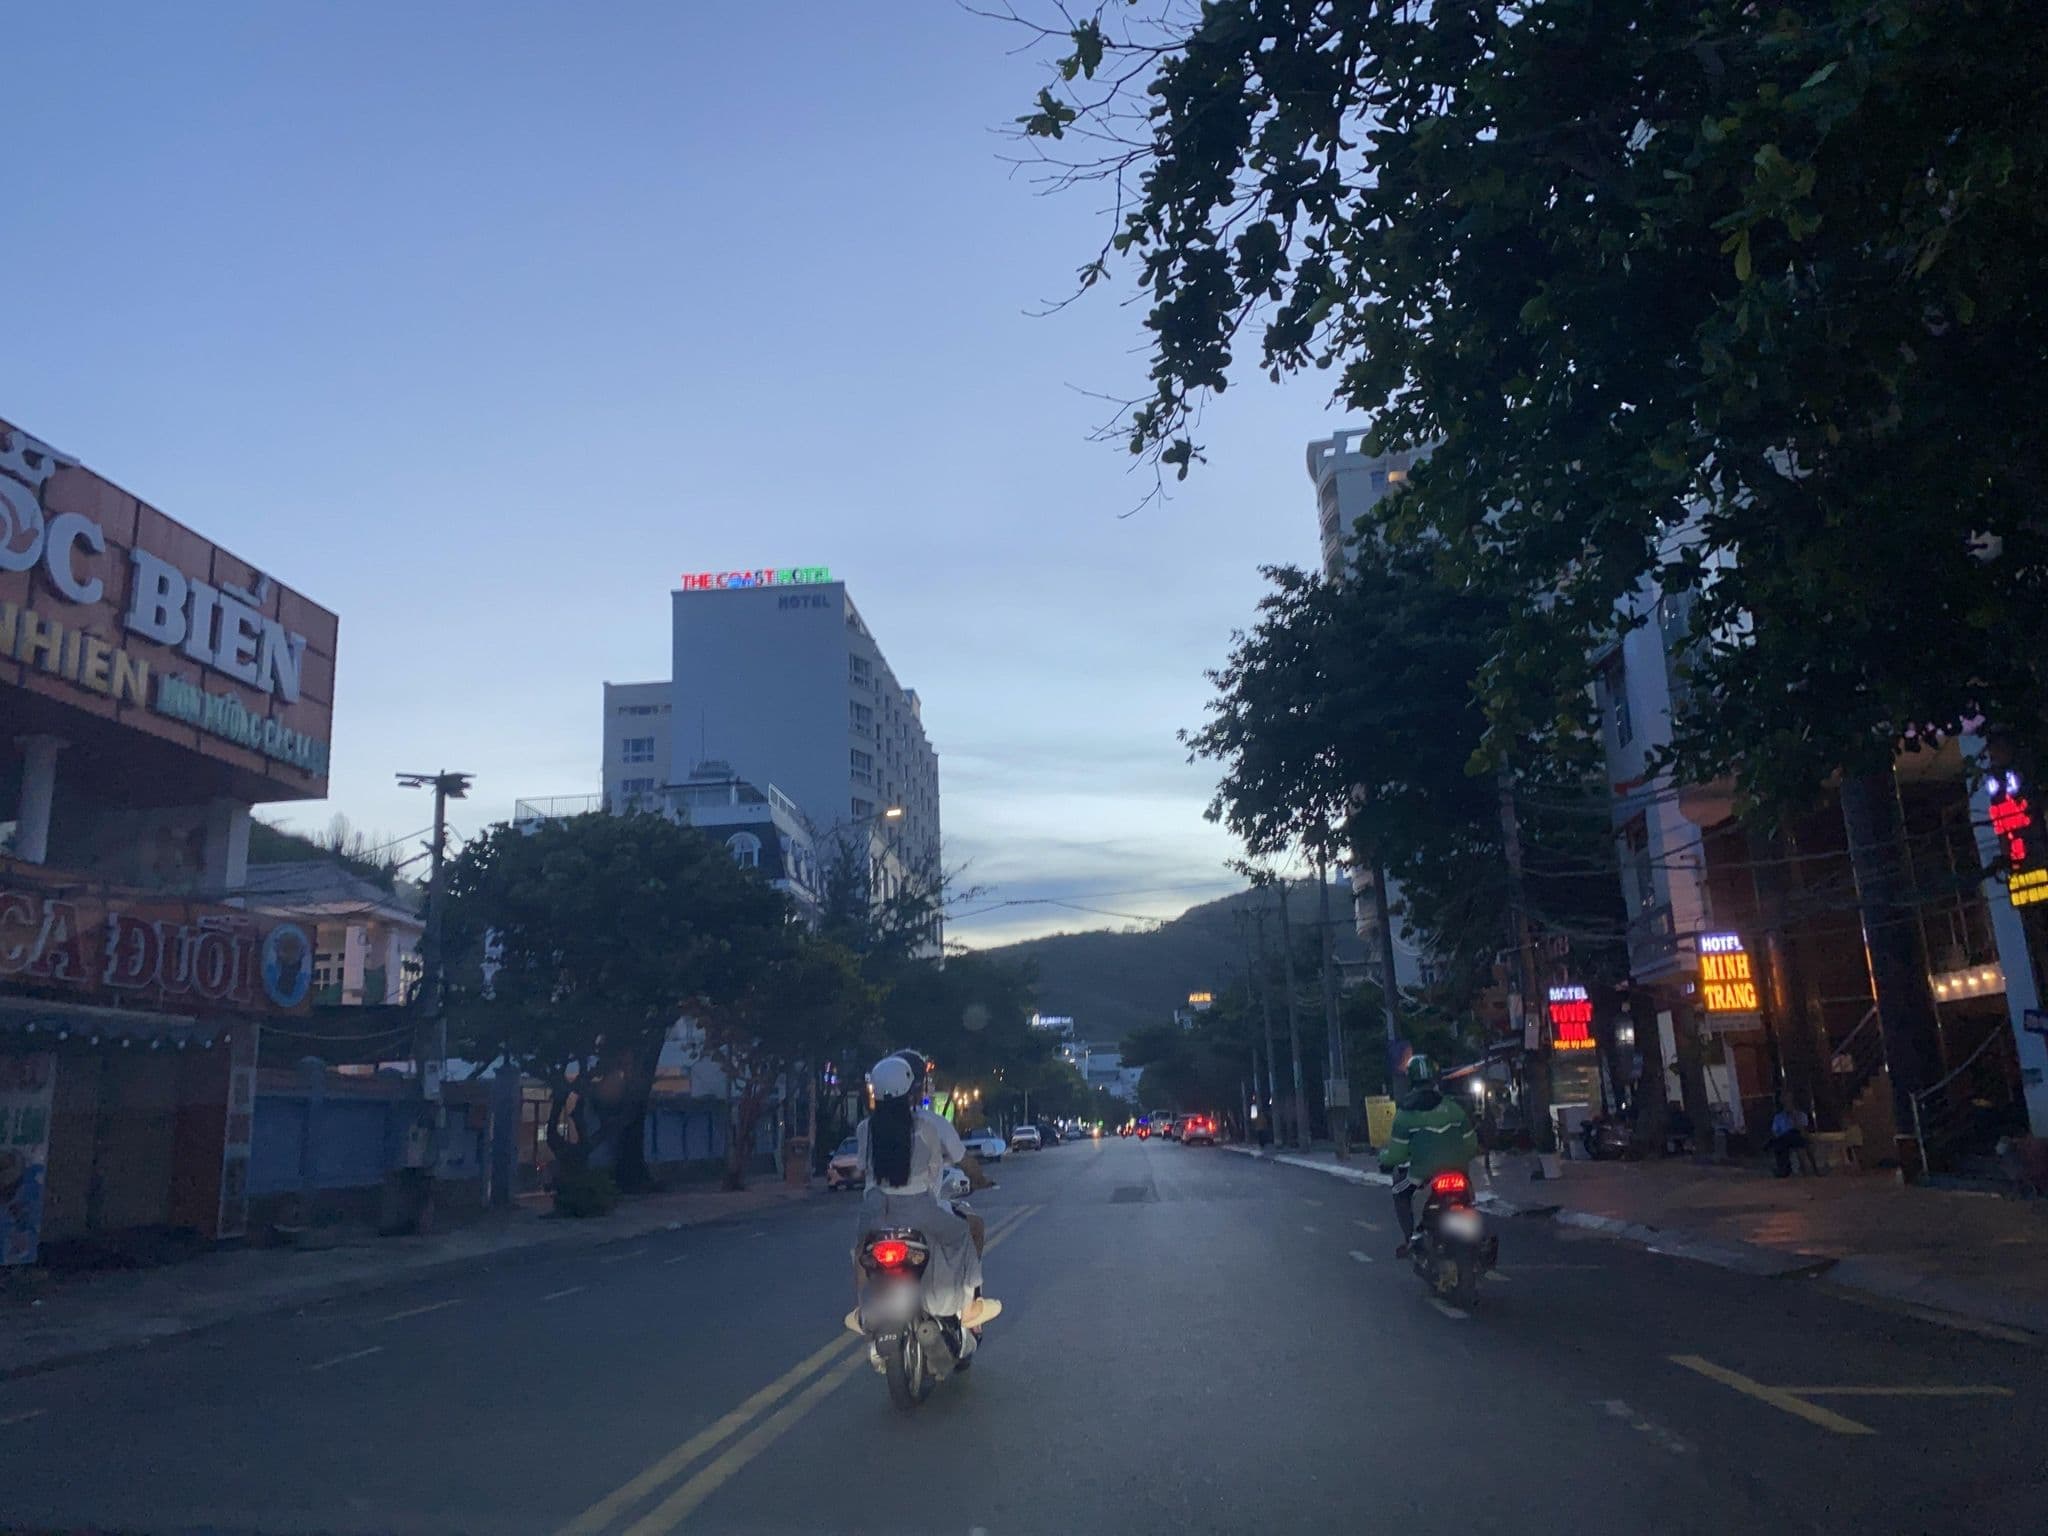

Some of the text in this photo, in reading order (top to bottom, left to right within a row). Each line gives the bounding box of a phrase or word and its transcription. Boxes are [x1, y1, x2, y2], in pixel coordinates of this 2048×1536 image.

[681, 565, 833, 591] THE COAST HOTEL
[778, 593, 831, 610] HOTEL
[1701, 936, 1744, 953] HOTEL
[1702, 953, 1751, 981] MINH
[1549, 986, 1588, 1001] MOTEL
[1704, 982, 1757, 1010] TRANG
